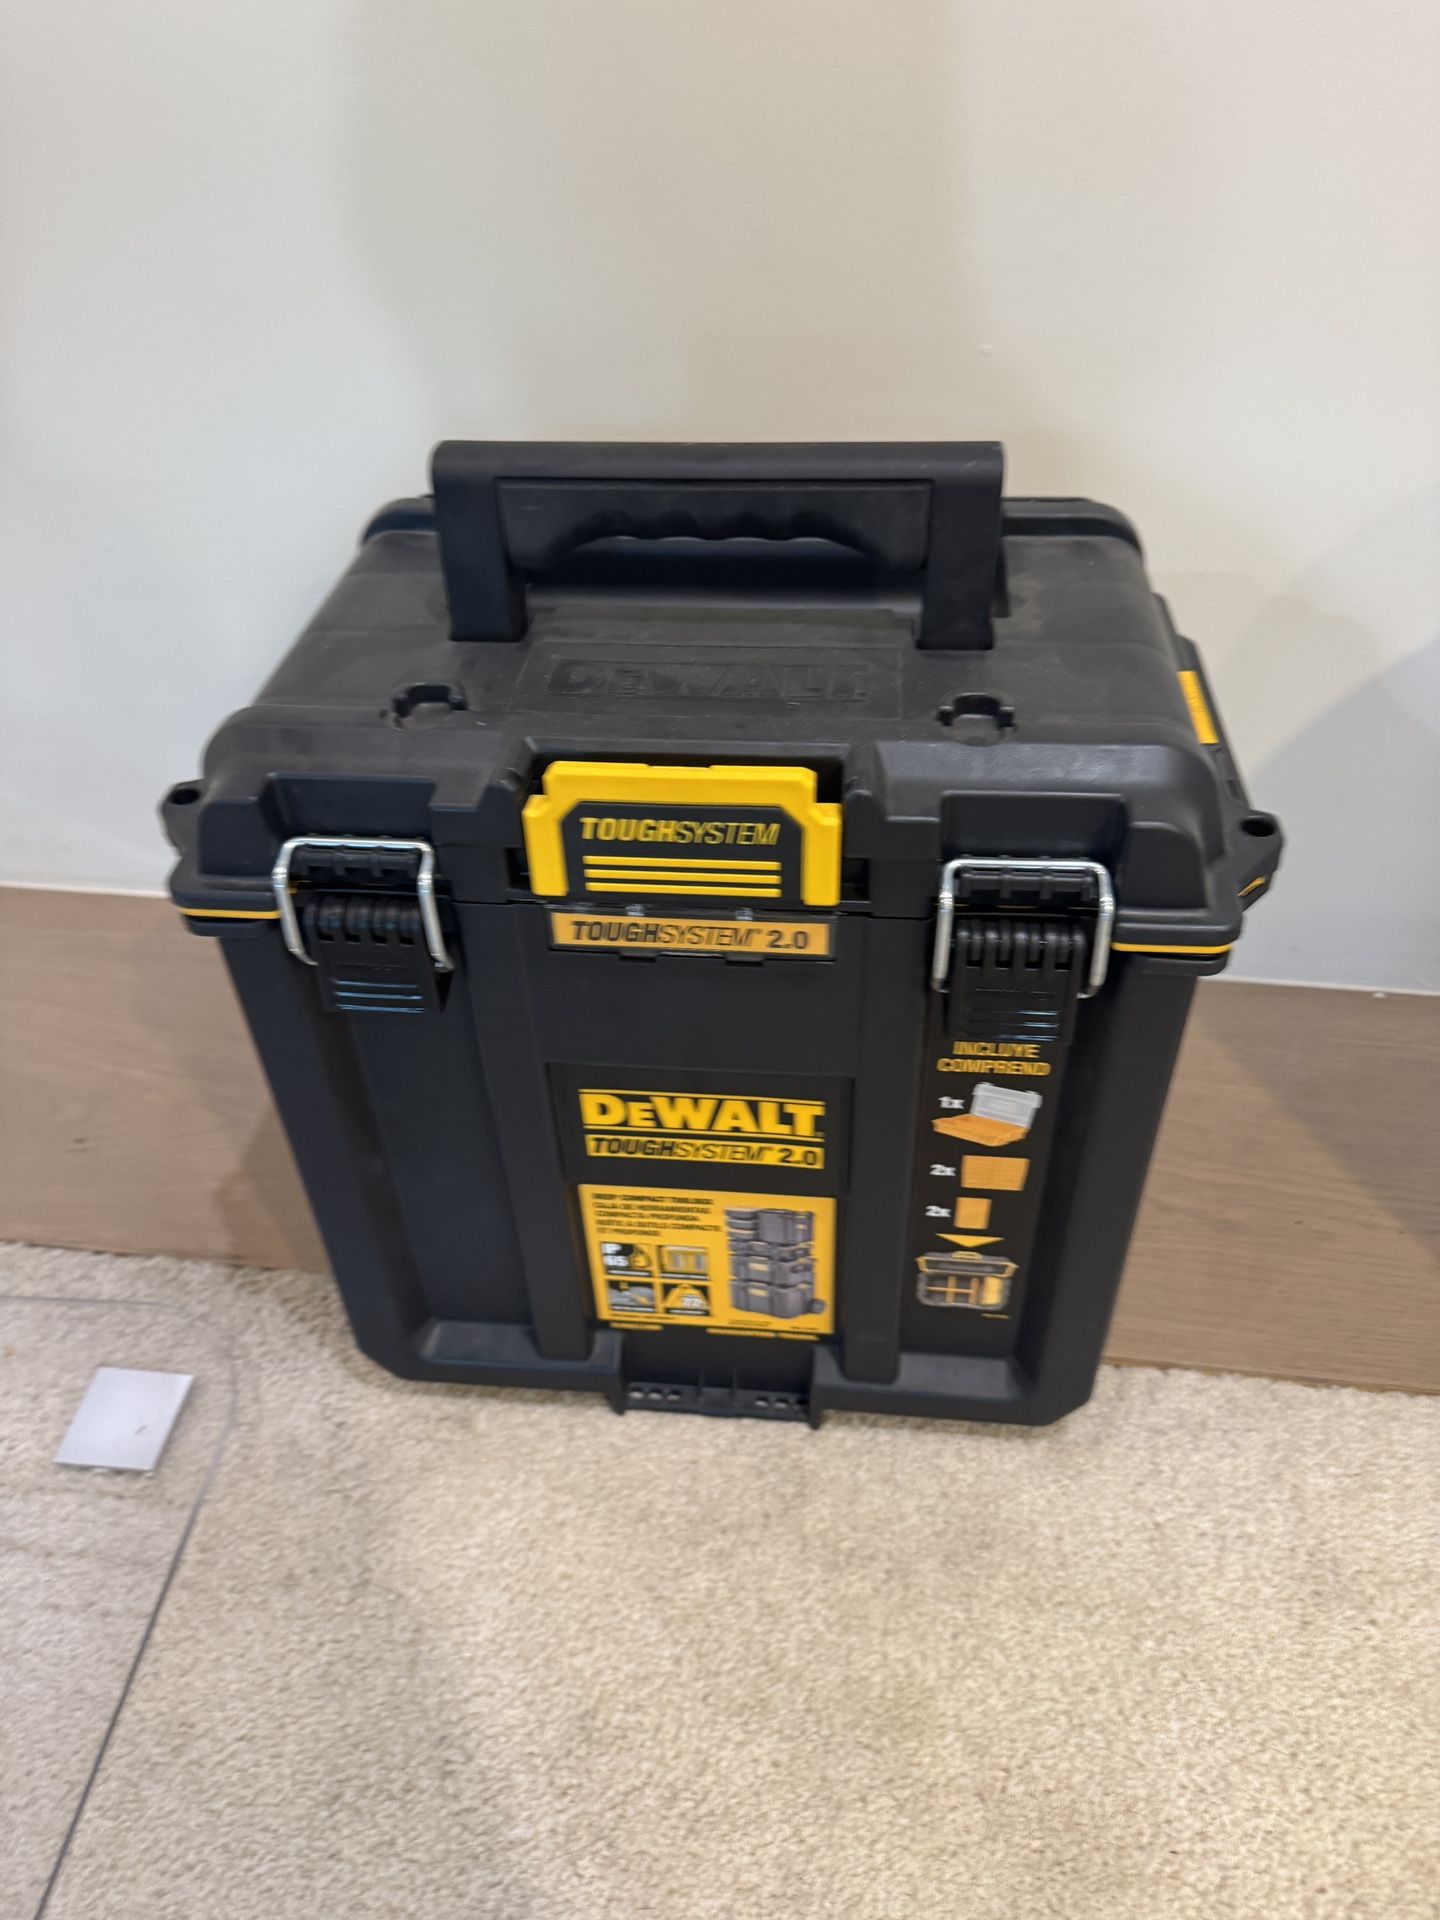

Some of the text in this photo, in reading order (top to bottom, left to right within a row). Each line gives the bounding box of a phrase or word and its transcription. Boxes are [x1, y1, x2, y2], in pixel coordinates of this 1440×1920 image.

[579, 816, 781, 846] TOUGHSYSTEM
[766, 929, 809, 950] 2.0
[952, 1040, 1042, 1059] INCLUYE
[936, 1057, 1053, 1076] COMPREND
[779, 1148, 818, 1167] 2.0
[929, 1163, 957, 1177] 2x
[924, 1204, 952, 1218] 2x
